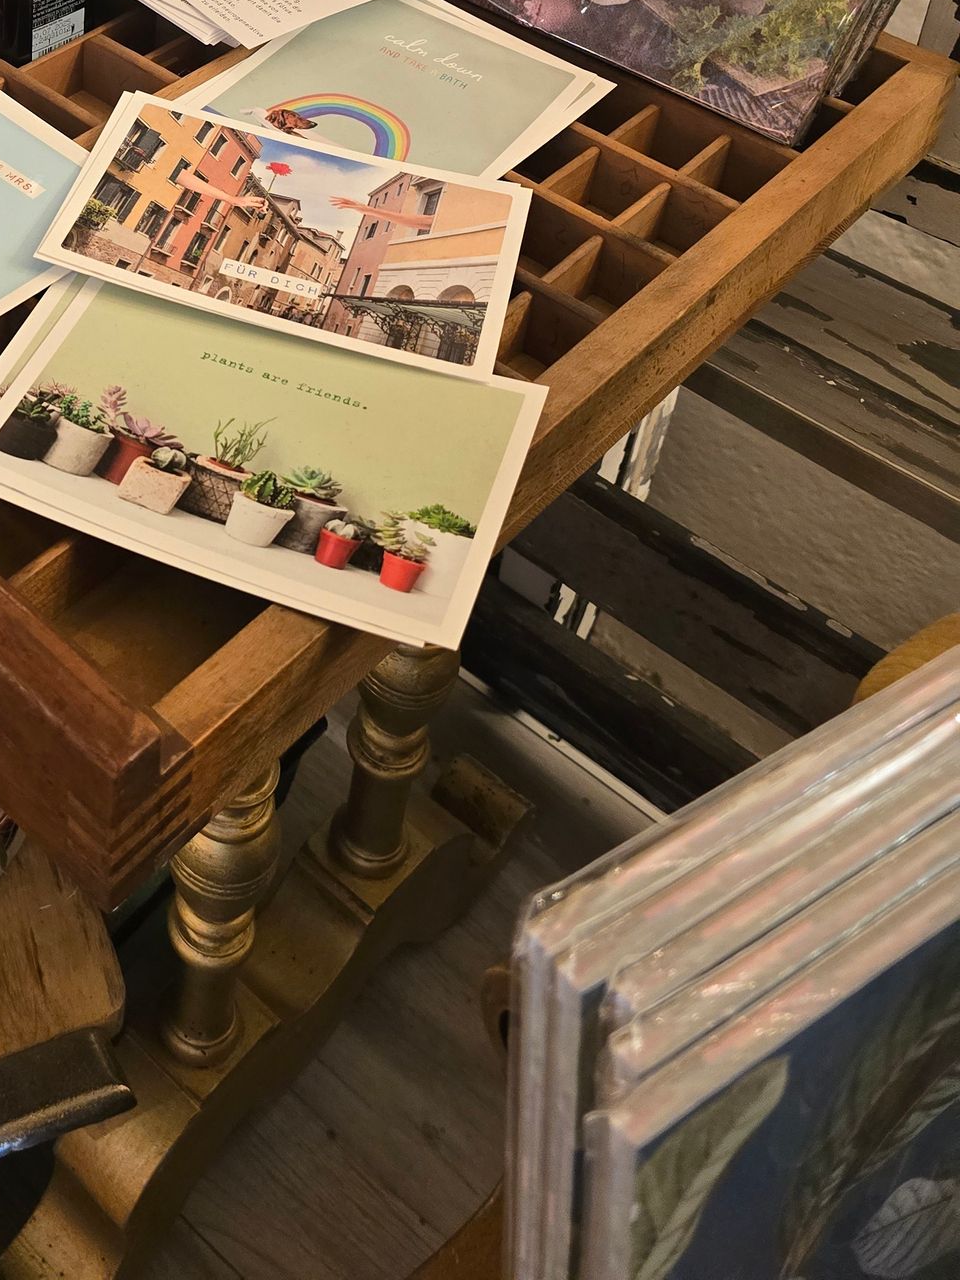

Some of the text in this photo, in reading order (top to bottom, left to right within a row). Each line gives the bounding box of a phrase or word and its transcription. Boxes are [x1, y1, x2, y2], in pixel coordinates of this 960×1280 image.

[379, 47, 400, 59] AND
[401, 56, 428, 72] TAKE
[439, 73, 468, 90] BATH
[383, 34, 482, 81] calm down
[5, 172, 33, 194] MRS.
[223, 263, 318, 296] FÜR DICH
[200, 351, 368, 410] plants are friends.
